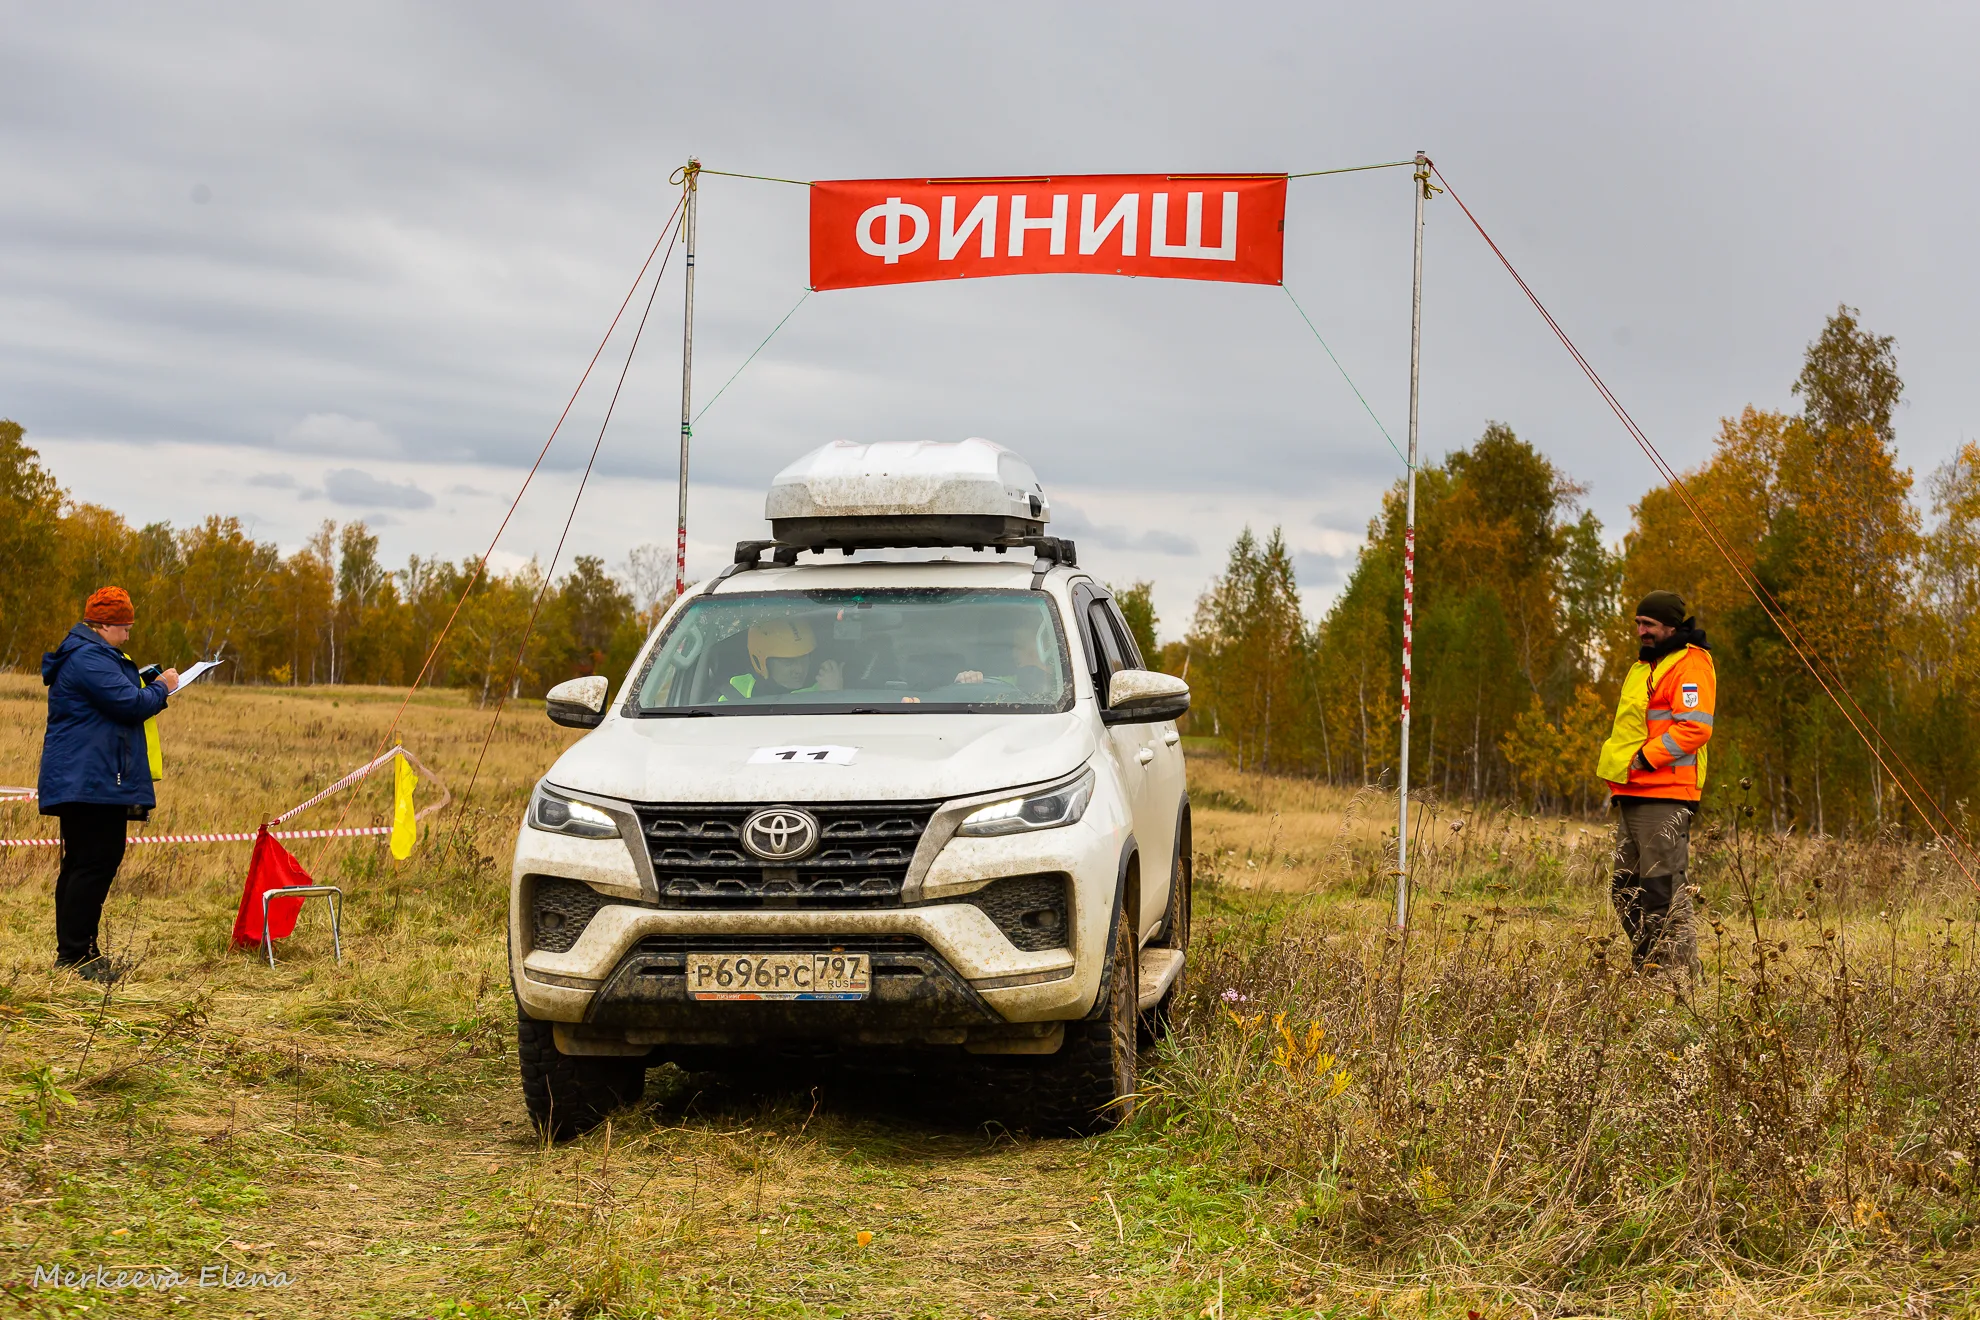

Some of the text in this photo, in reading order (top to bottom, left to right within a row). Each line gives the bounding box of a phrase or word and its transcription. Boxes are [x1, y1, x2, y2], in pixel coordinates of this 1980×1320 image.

[856, 191, 1239, 264] ФИНИШ
[775, 751, 829, 760] 11
[816, 956, 861, 979] 797
[827, 979, 849, 988] RUS
